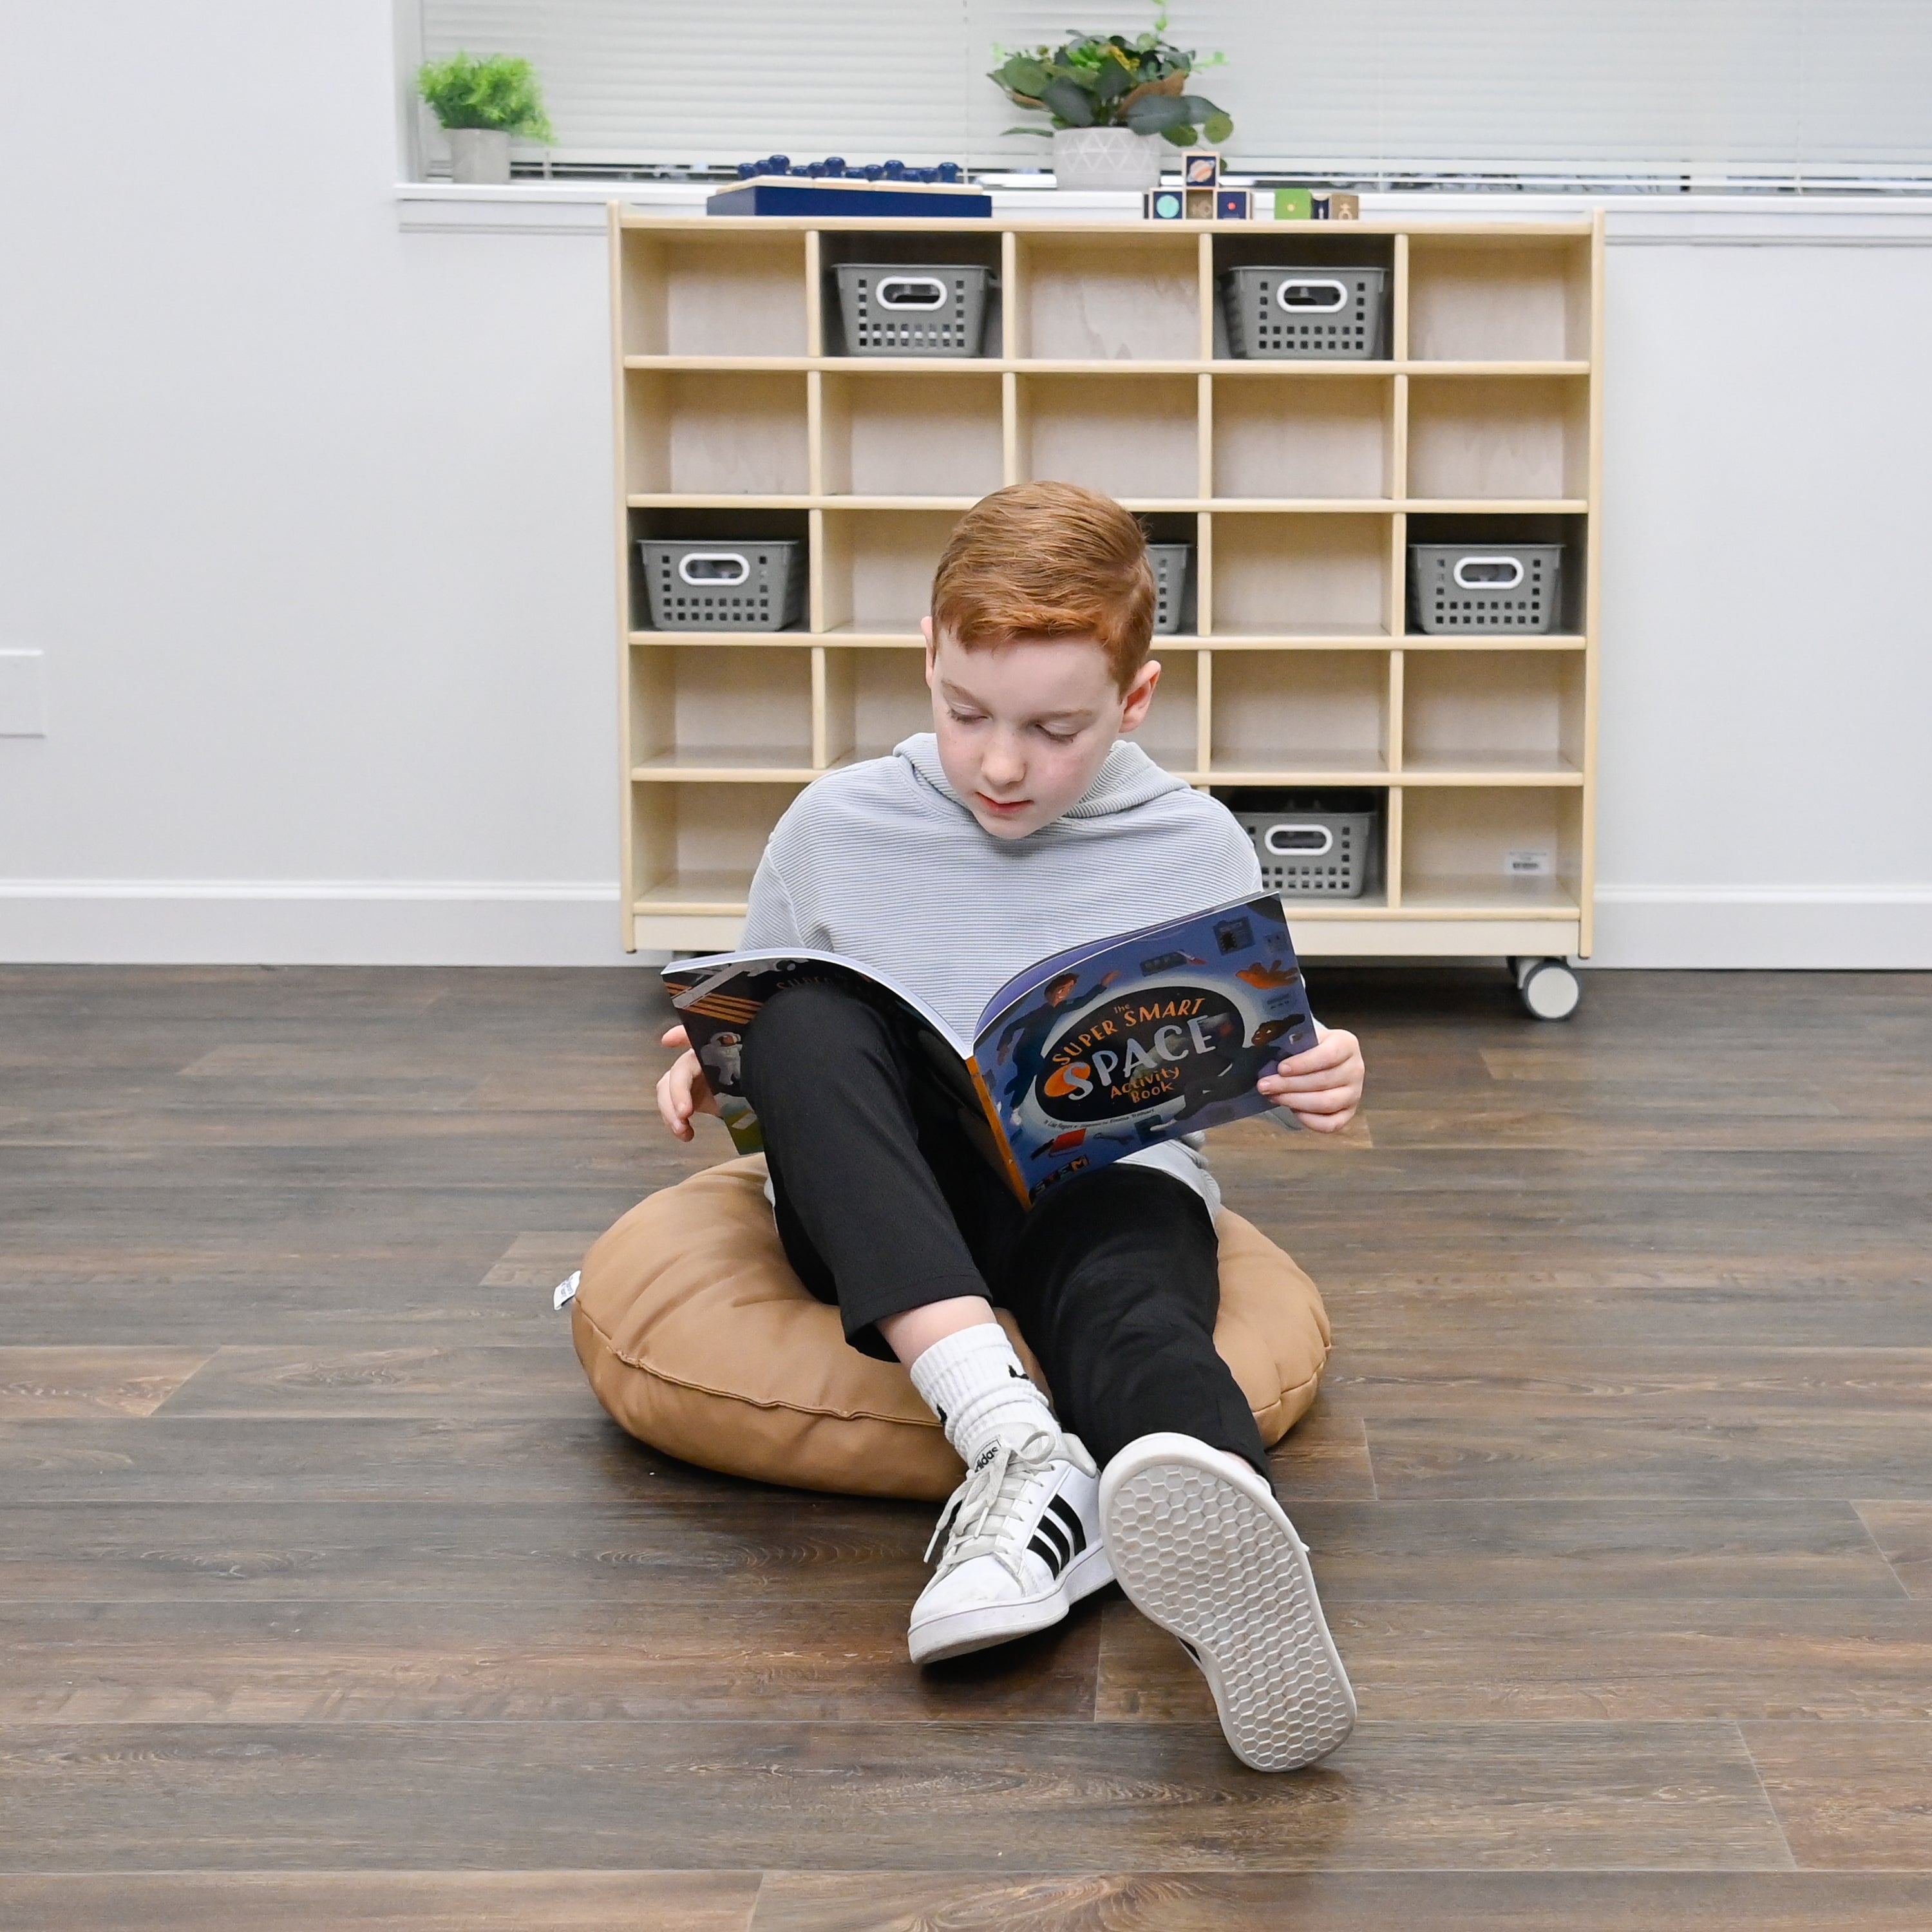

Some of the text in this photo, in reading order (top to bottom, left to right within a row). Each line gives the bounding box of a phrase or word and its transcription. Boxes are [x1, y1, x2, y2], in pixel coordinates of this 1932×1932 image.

[1113, 1003, 1130, 1014] The
[1052, 998, 1206, 1065] SUPER SMART
[1063, 1015, 1217, 1101] SPACE
[1111, 1066, 1180, 1099] Activity
[1132, 1081, 1175, 1103] Book
